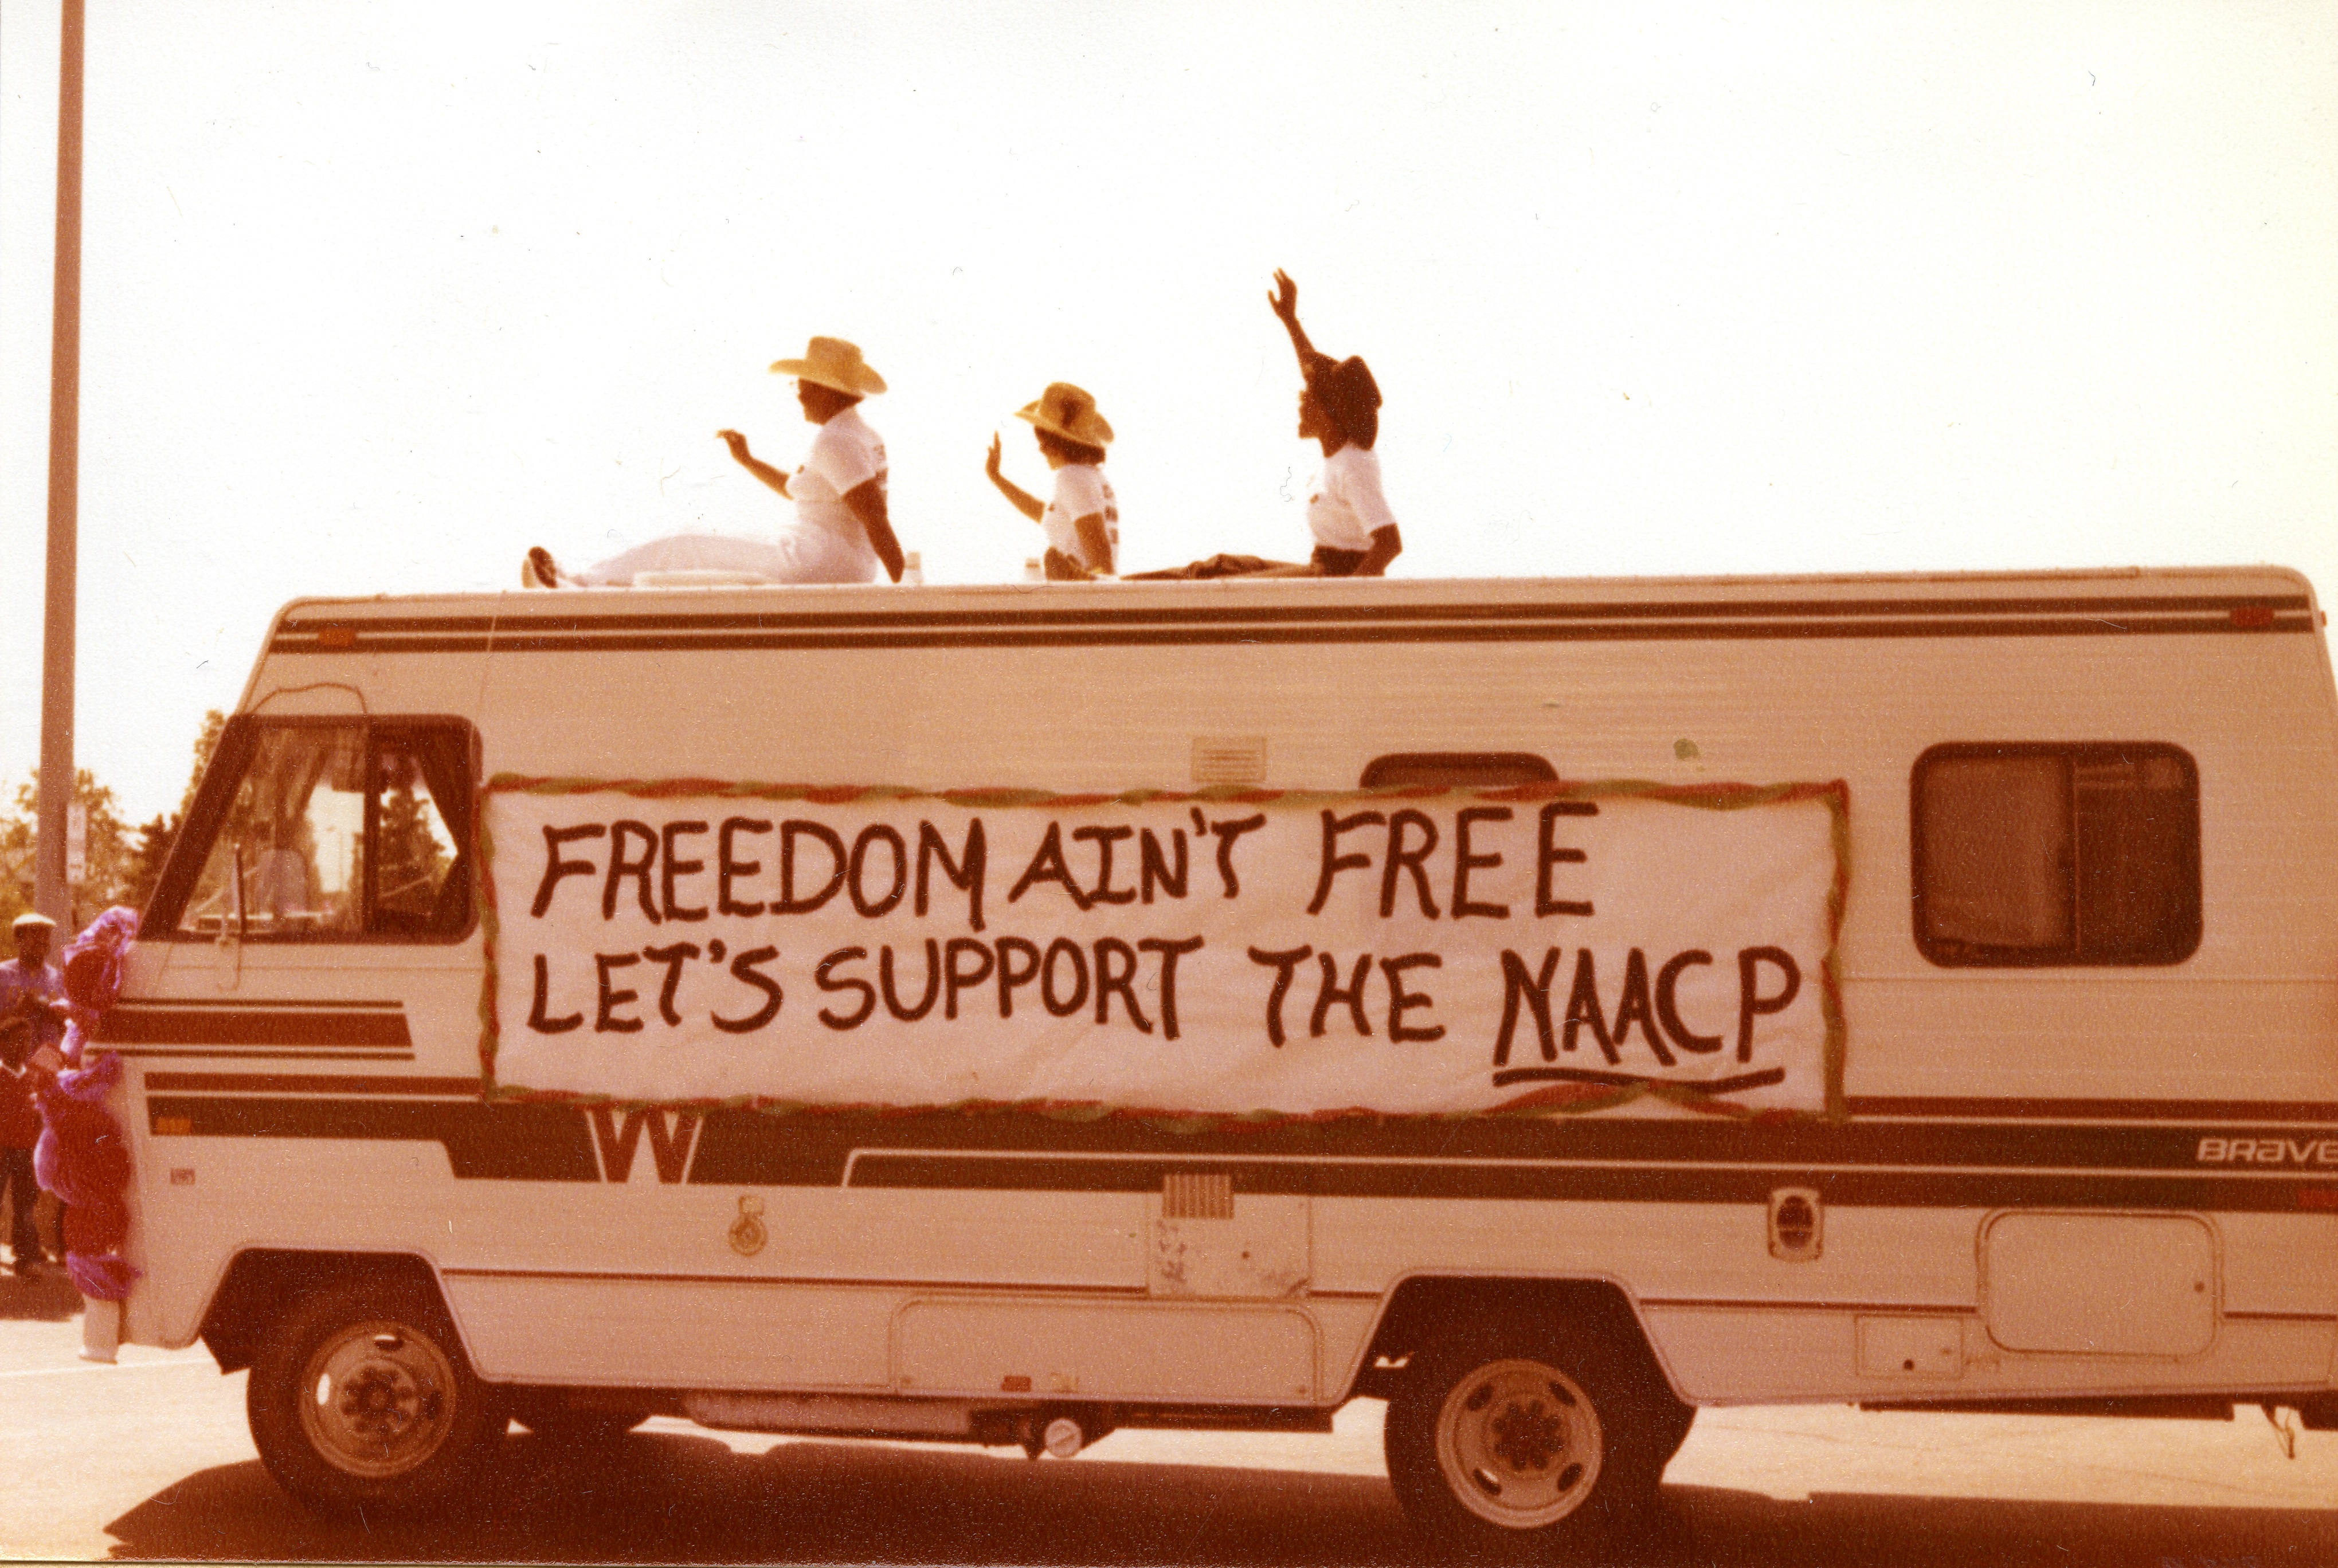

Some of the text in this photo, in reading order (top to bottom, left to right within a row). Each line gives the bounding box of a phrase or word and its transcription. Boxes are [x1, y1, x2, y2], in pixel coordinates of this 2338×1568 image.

[531, 801, 1600, 932] FREEDOM AIN'T FREE
[527, 935, 1803, 1068] LET'S SUPPORT THE NAACP
